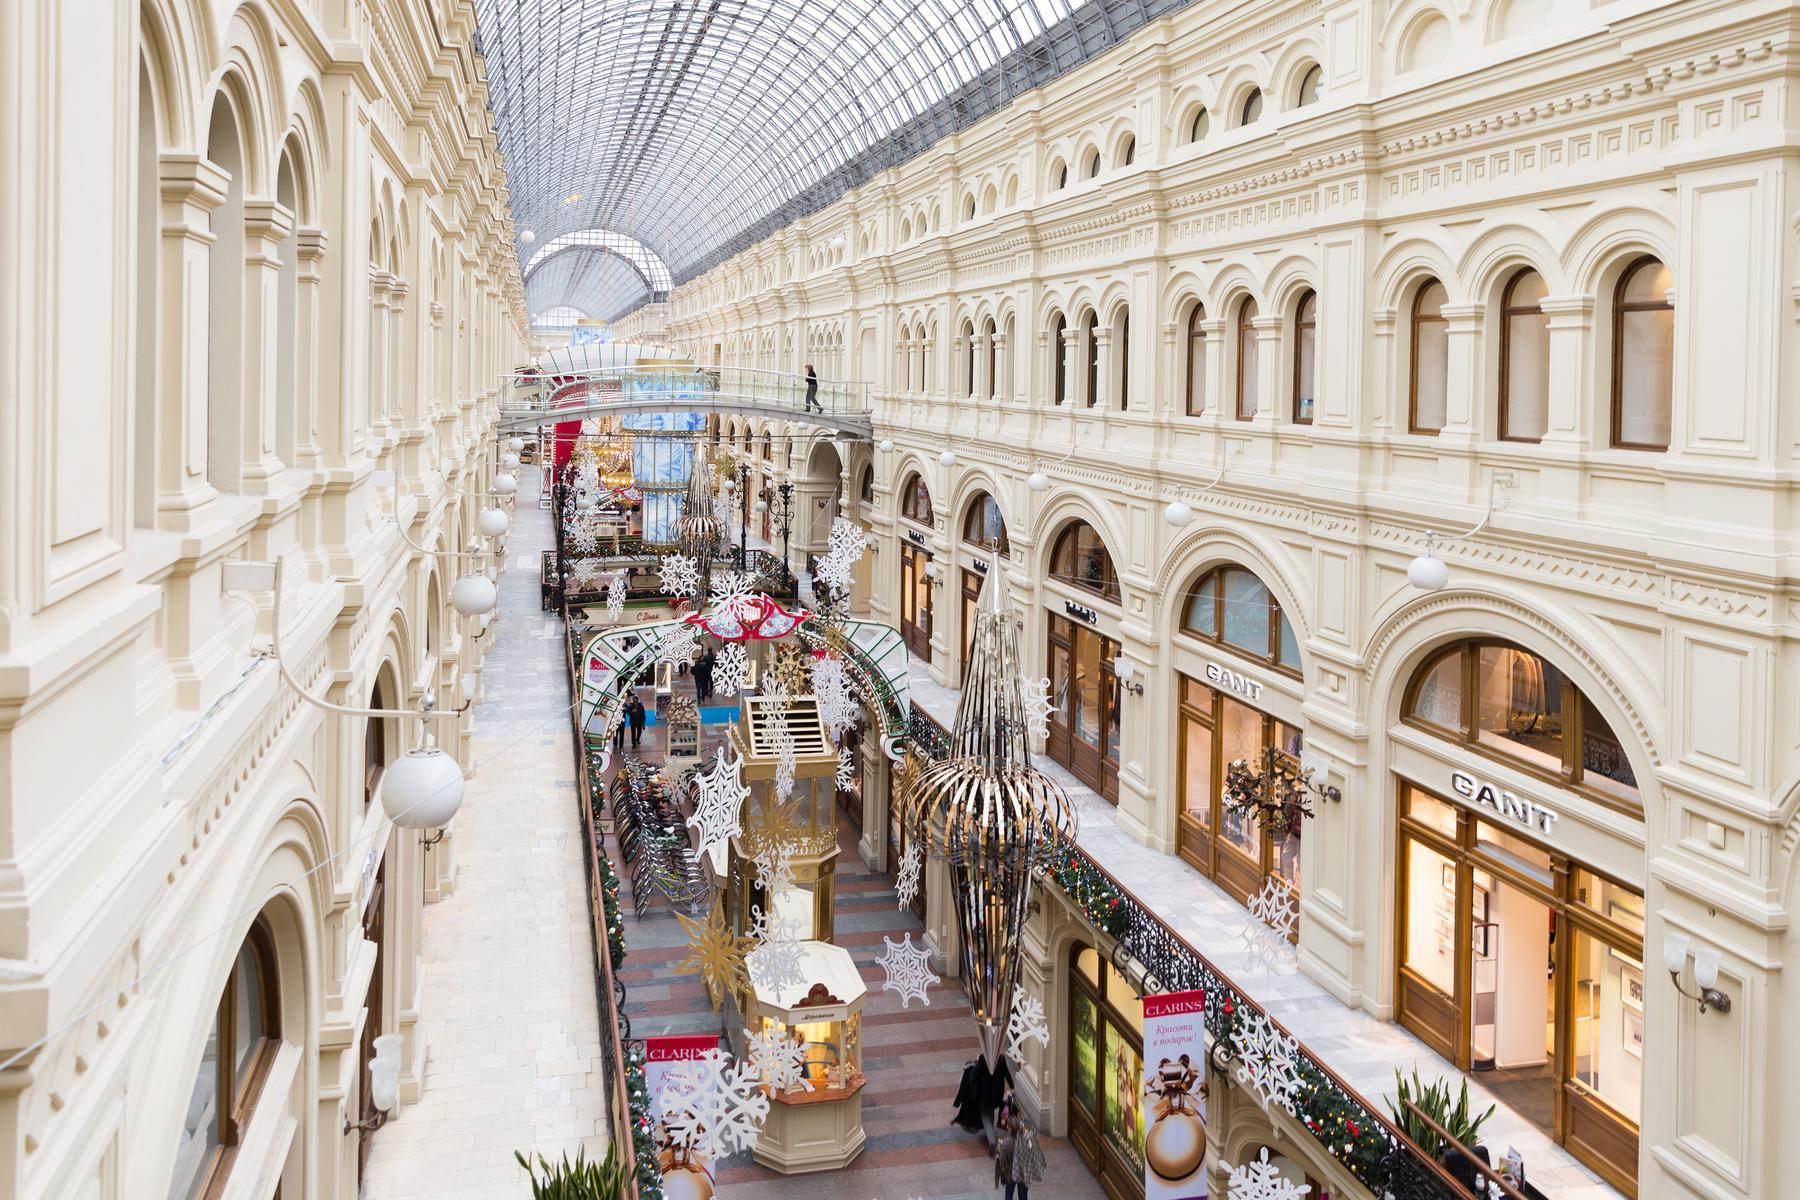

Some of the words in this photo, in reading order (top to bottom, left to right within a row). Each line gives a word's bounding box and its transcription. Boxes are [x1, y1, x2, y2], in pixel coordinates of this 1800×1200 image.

[1206, 662, 1263, 700] GANT
[1452, 769, 1557, 834] GANT
[1146, 1001, 1202, 1016] CLARINS
[1156, 1024, 1193, 1037] Красота
[1160, 1033, 1197, 1047] подарок!
